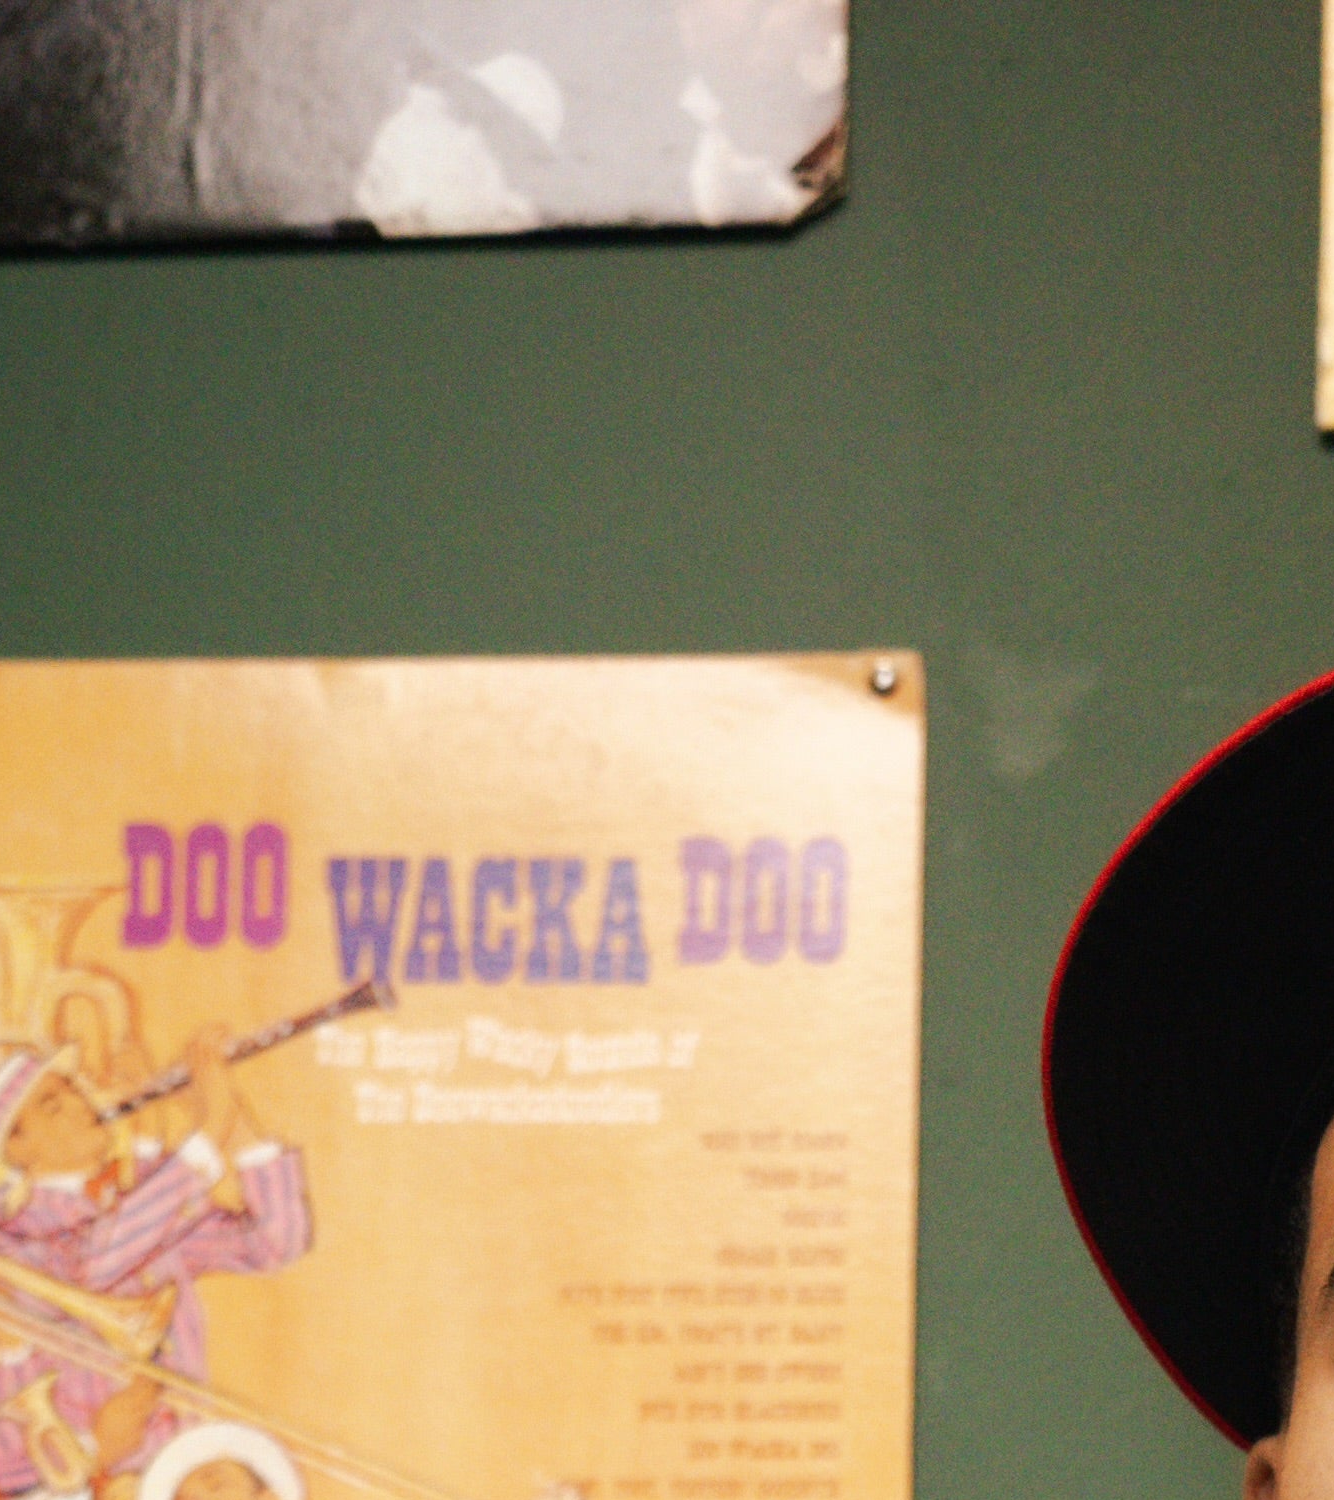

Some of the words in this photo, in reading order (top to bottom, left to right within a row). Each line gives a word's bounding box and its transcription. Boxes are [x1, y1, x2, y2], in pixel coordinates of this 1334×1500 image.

[121, 821, 290, 952] DOO
[325, 855, 651, 986] WACKA
[673, 834, 851, 968] DOO
